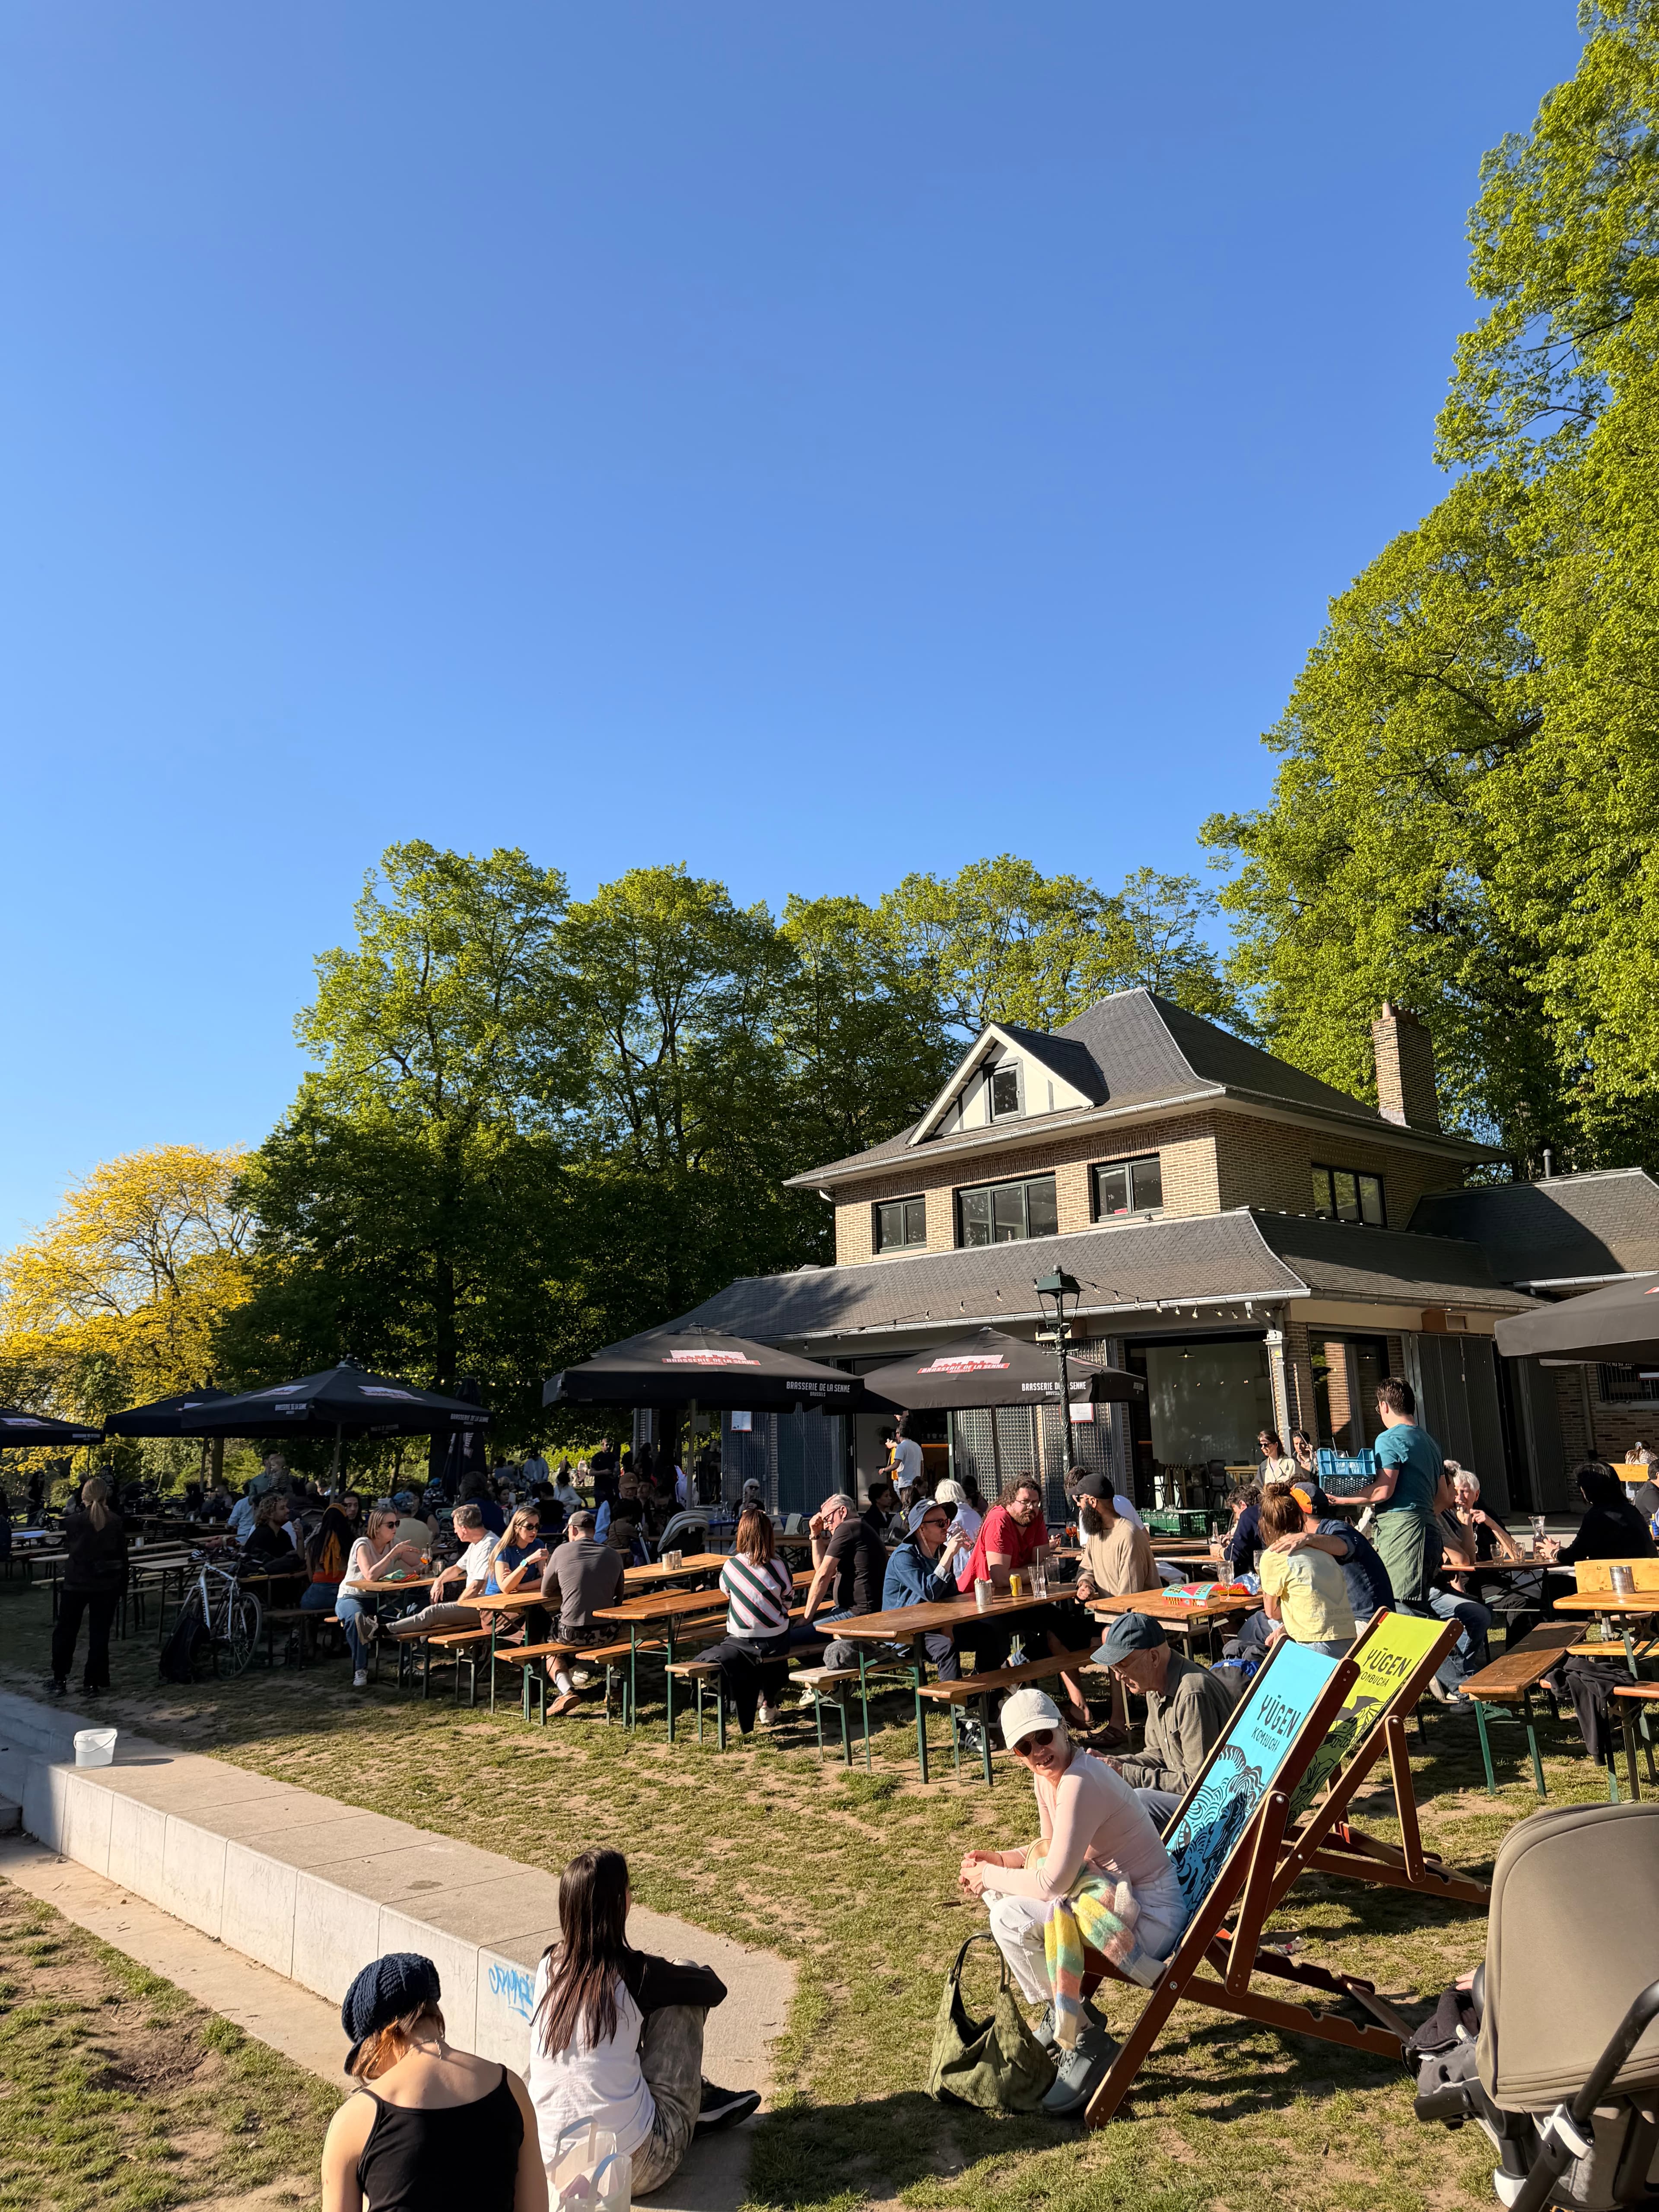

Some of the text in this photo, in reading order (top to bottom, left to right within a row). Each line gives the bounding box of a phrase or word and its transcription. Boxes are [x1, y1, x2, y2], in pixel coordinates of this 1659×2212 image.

[786, 1381, 817, 1391] BRASSERIE
[834, 1384, 850, 1393] SENNE
[1022, 1382, 1053, 1391] BRASSERIE
[1069, 1381, 1086, 1390] SENNE
